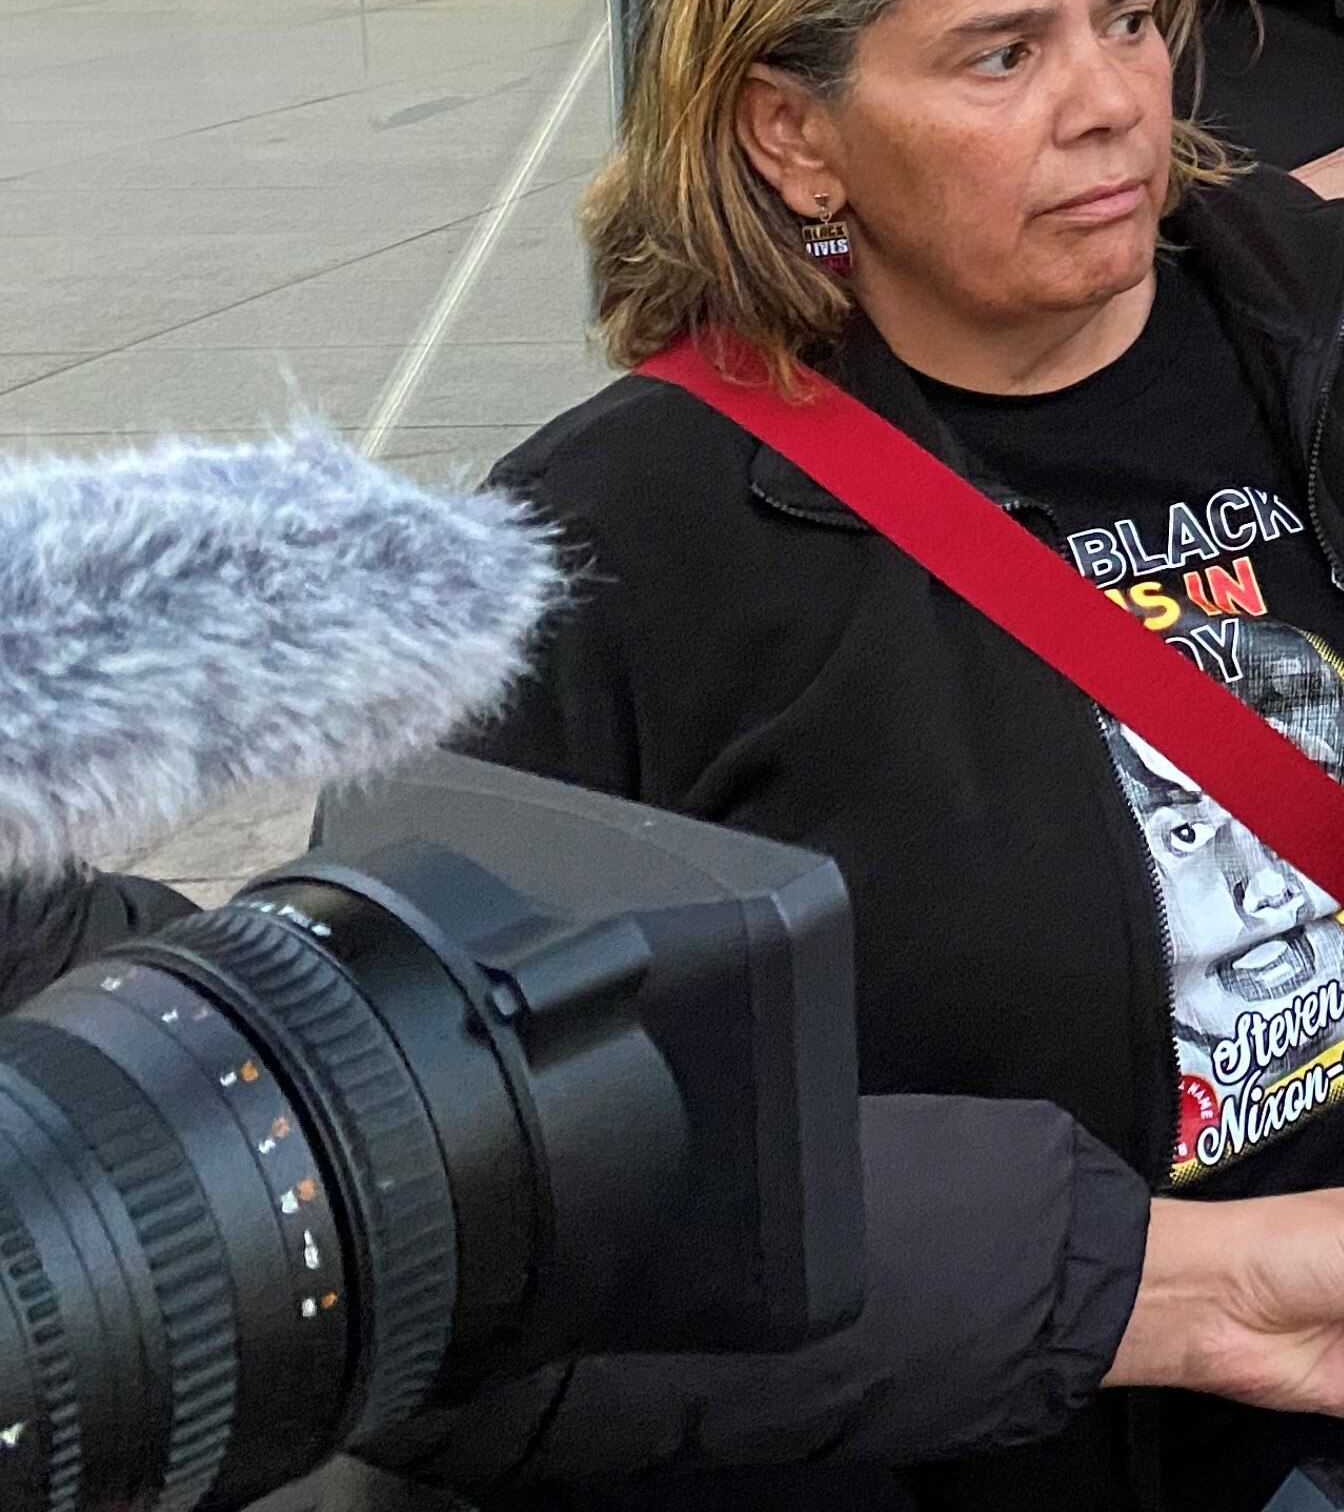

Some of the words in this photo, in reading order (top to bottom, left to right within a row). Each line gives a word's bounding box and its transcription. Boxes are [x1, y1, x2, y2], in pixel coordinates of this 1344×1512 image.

[1066, 486, 1304, 589] BLACK
[1183, 555, 1268, 618] IN
[1187, 1081, 1214, 1120] NAME
